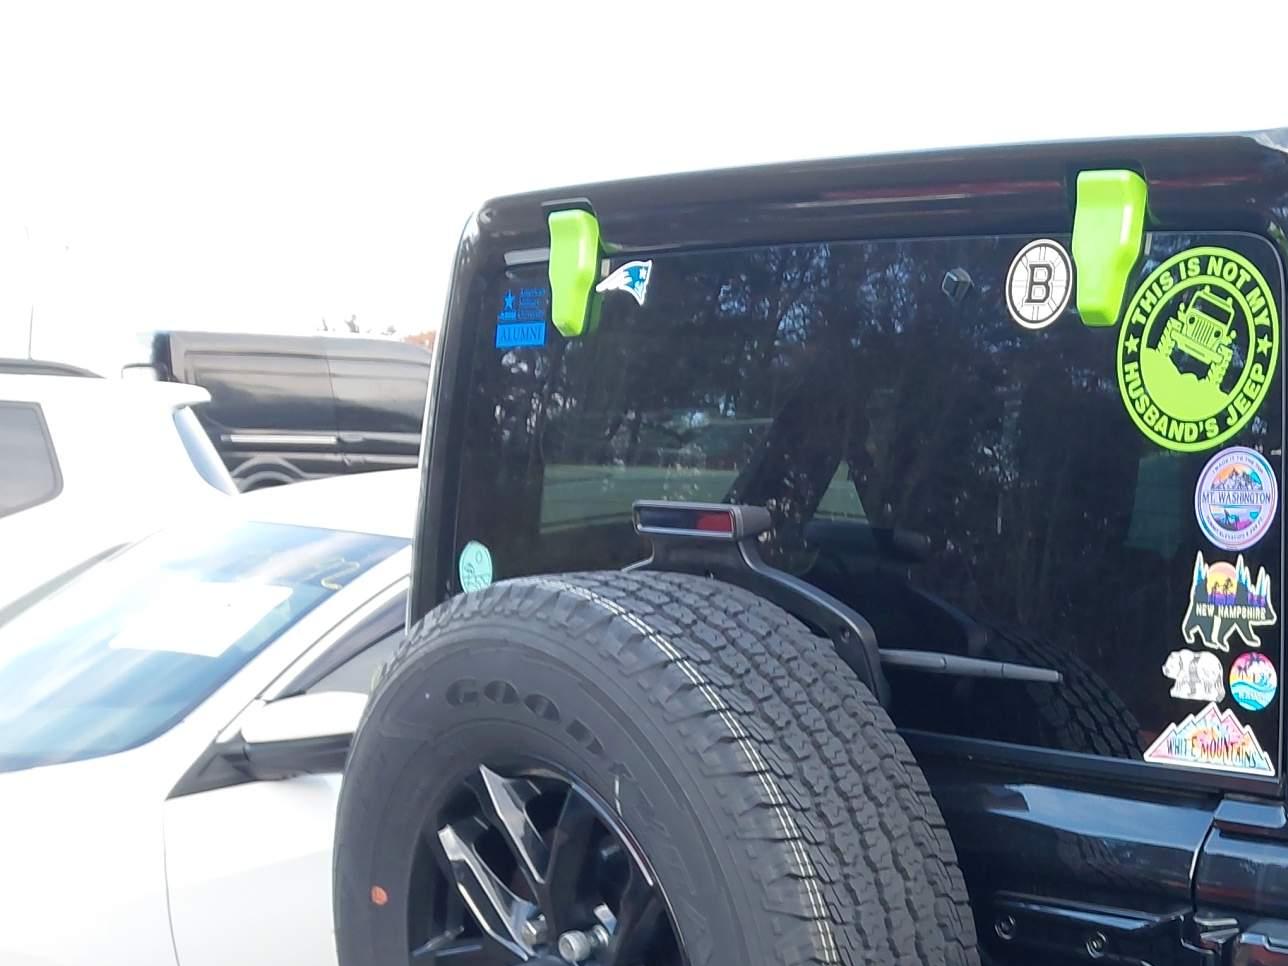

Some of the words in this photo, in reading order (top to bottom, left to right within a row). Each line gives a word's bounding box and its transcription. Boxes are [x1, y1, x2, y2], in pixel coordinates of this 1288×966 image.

[1024, 263, 1052, 303] B
[1132, 271, 1175, 325] THIS
[1178, 257, 1200, 281] IS
[1207, 255, 1251, 287] NOT
[1249, 286, 1271, 327] MY
[1124, 361, 1219, 442] HUSBAND'S
[1226, 363, 1266, 425] JEEP
[1218, 491, 1271, 505] WASHINGTON
[1195, 602, 1215, 617] NEW
[1217, 605, 1267, 620] HAMPSHIRE
[1166, 735, 1198, 758] WHITE
[1200, 738, 1257, 768] MOUNTAINS
